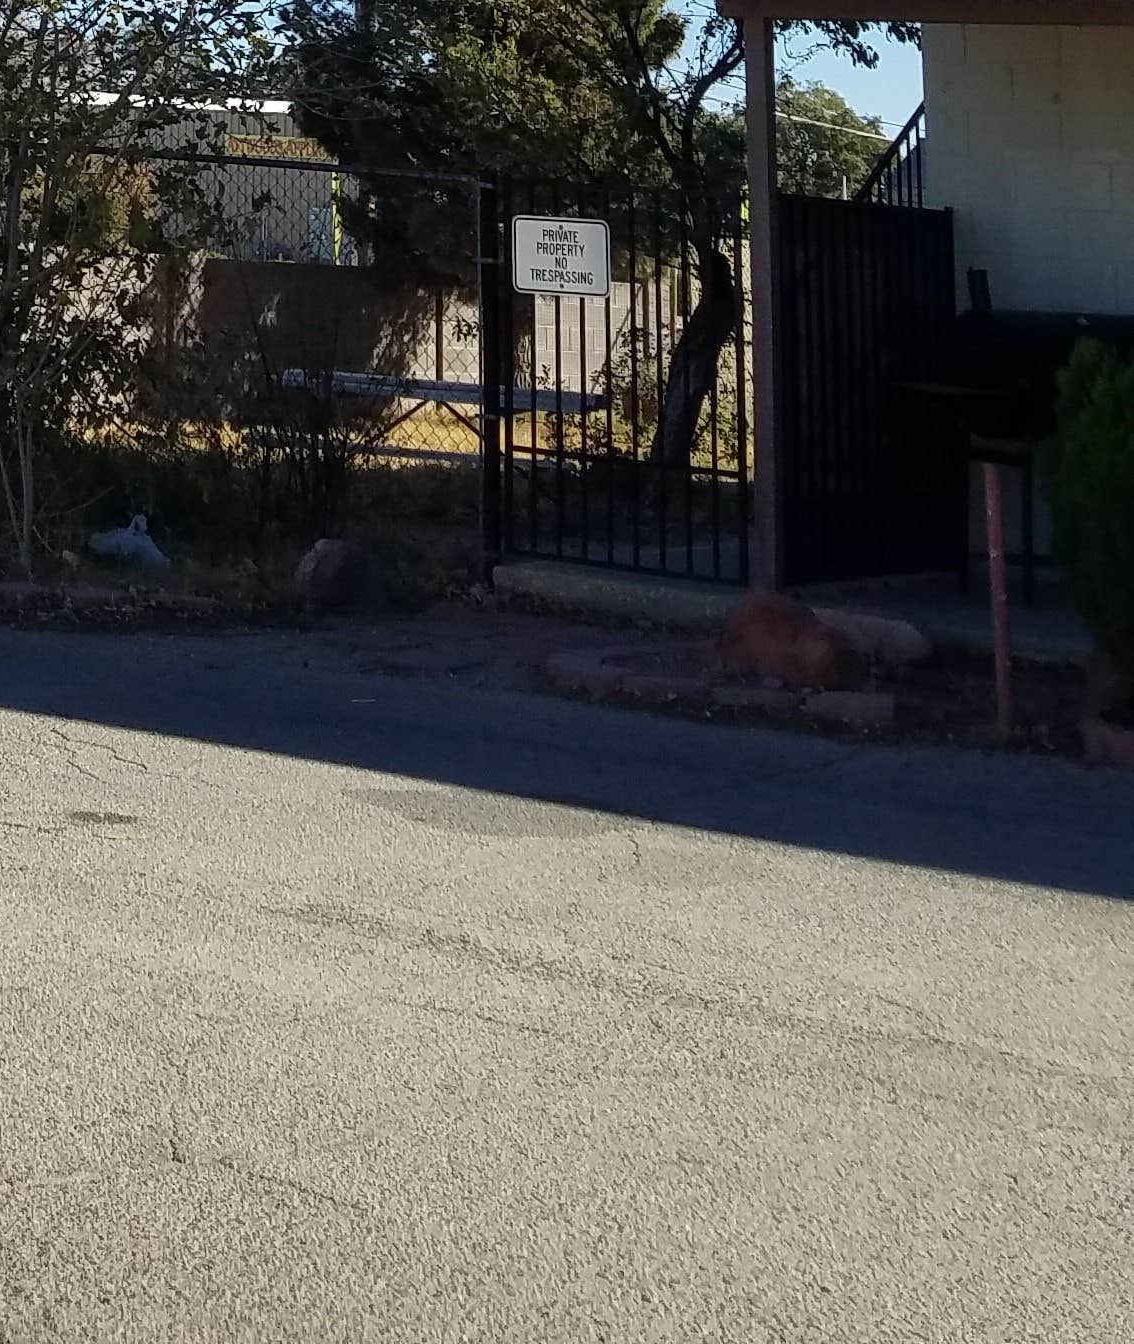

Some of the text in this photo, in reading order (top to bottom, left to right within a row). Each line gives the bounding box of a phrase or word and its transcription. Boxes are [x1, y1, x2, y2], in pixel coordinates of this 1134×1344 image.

[542, 229, 579, 244] PRIVATE
[536, 243, 586, 257] PROPERTY
[554, 257, 568, 269] NO
[530, 268, 594, 286] TRESPASSING
